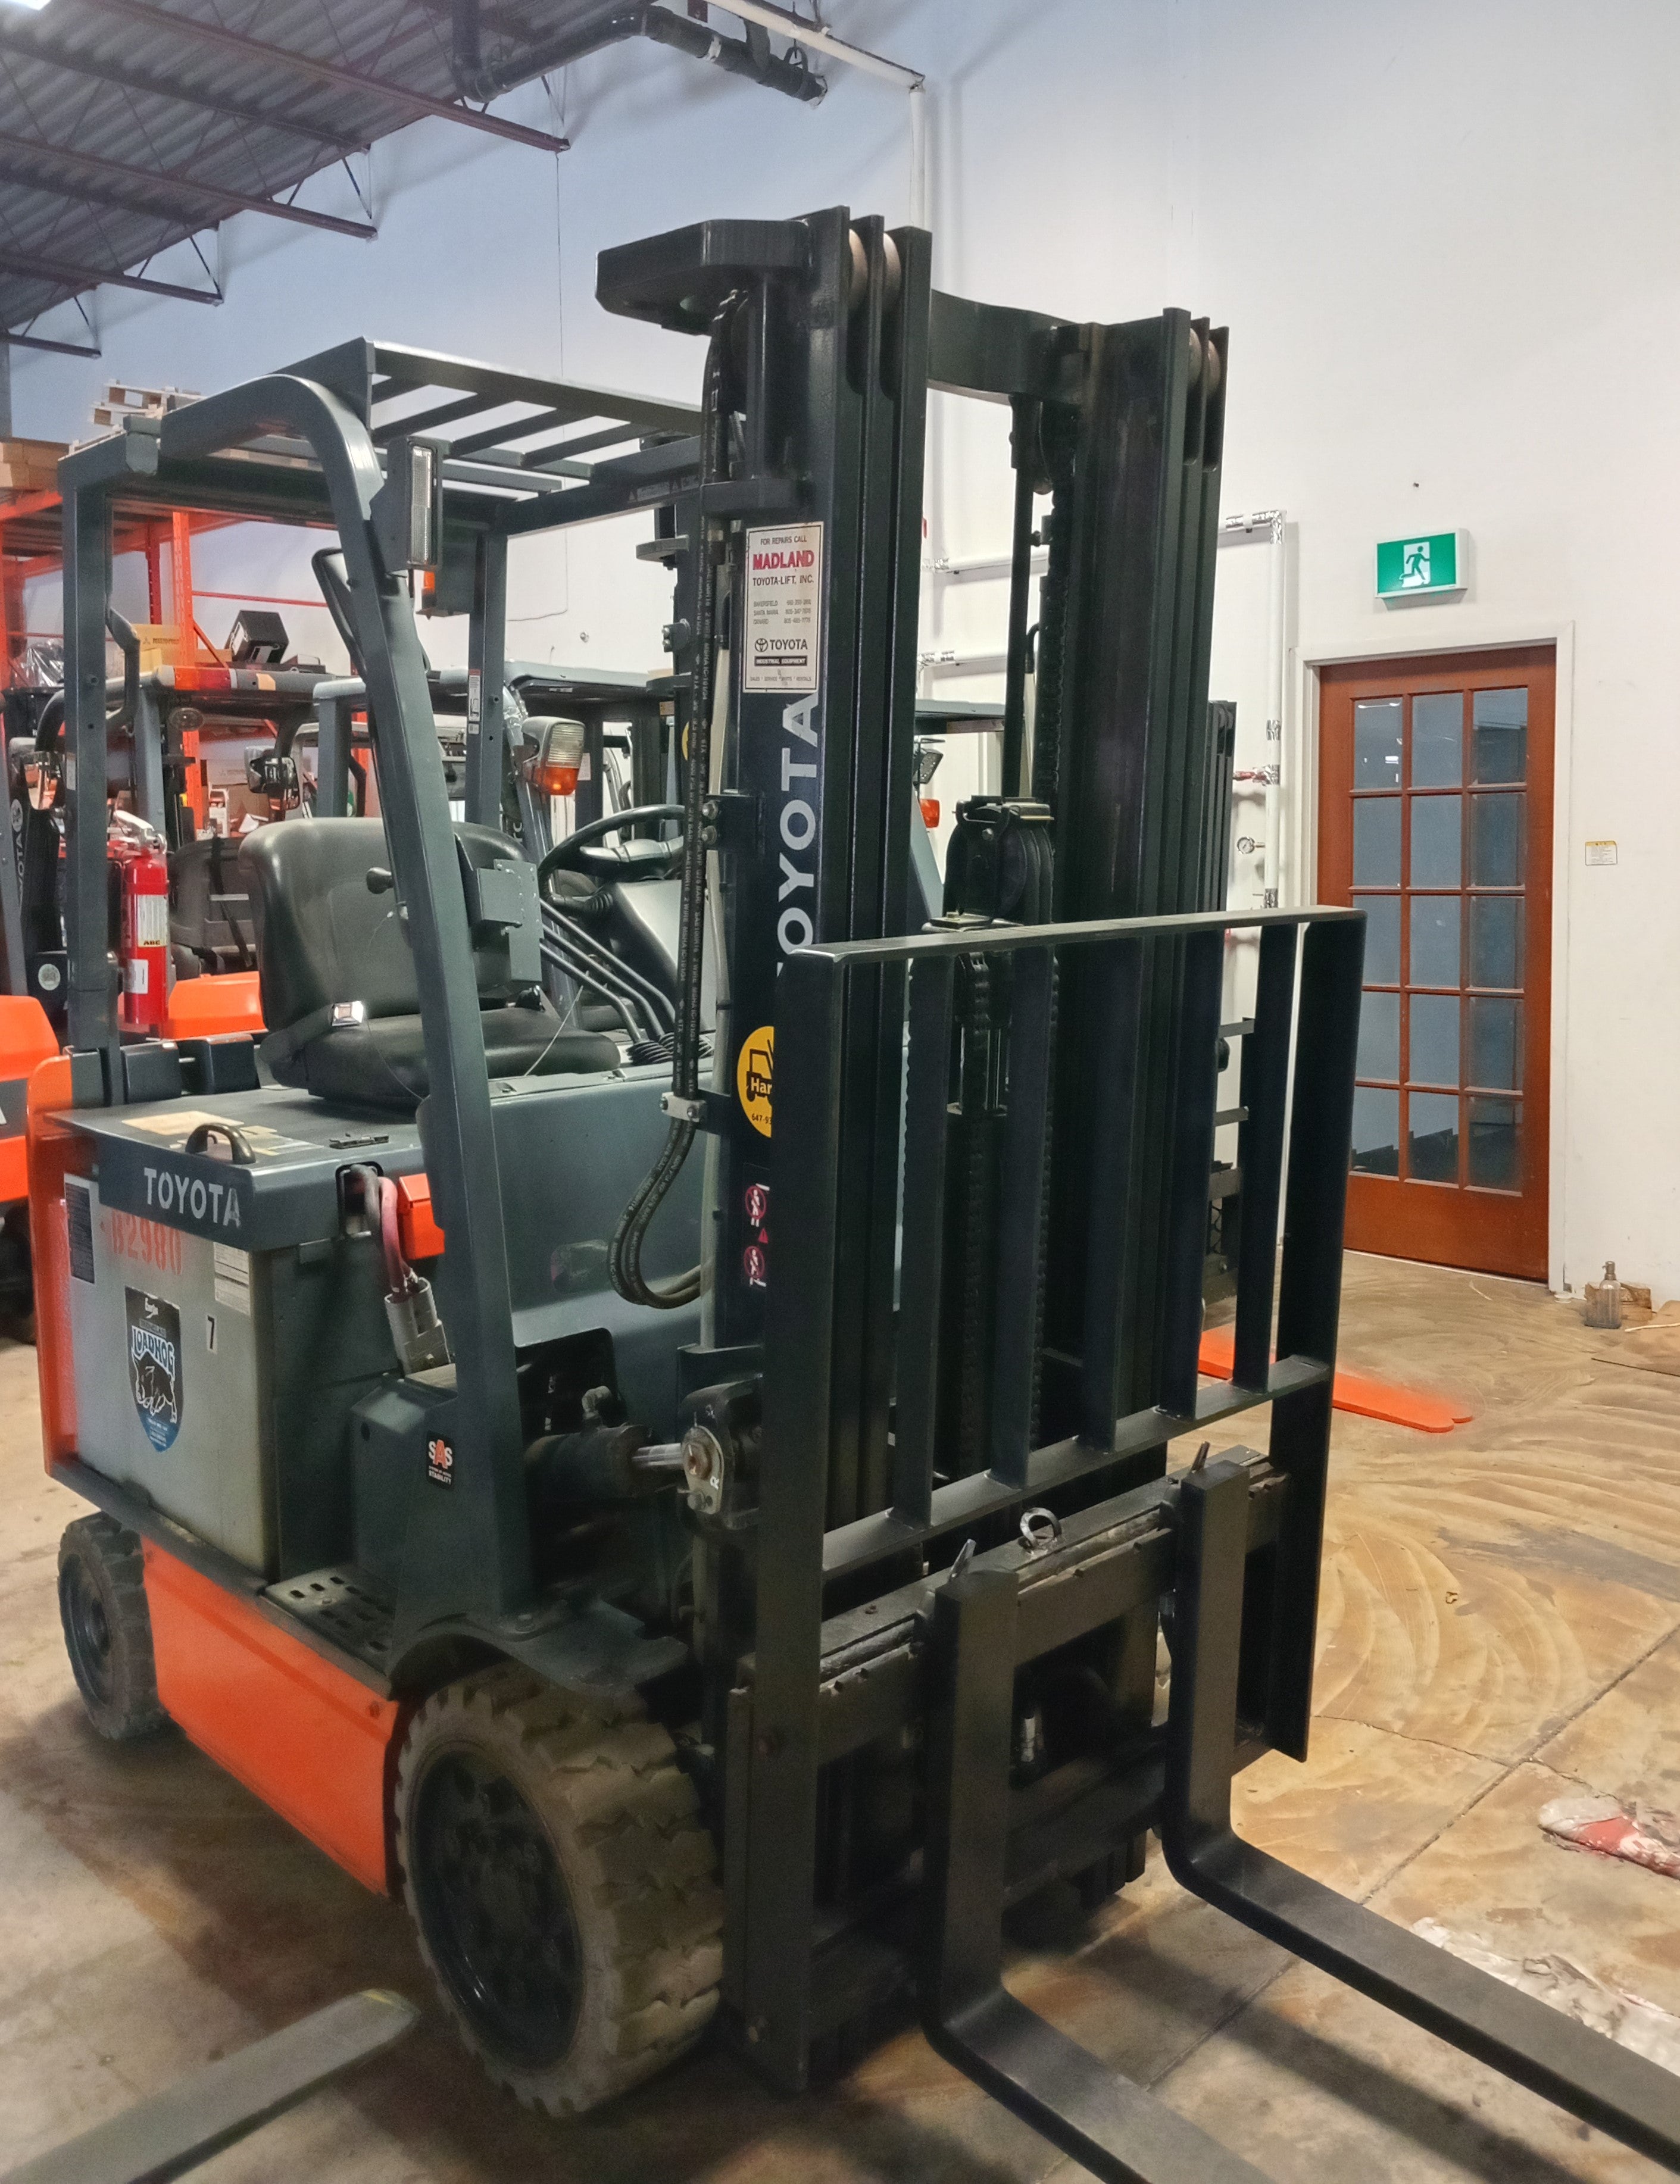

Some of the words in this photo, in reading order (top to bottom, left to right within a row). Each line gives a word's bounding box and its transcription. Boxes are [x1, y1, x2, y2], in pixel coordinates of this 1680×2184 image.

[772, 536, 792, 545] REPAIRS
[752, 550, 815, 570] MADLAND
[800, 574, 814, 584] INC.
[769, 639, 808, 651] TOYOTA
[776, 693, 818, 977] OYOTA
[144, 1167, 242, 1228] TOYOTA
[207, 1316, 216, 1349] 7
[132, 1325, 175, 1374] LOADHOG
[428, 1439, 453, 1469] SAS
[429, 1470, 451, 1485] STABILITY
